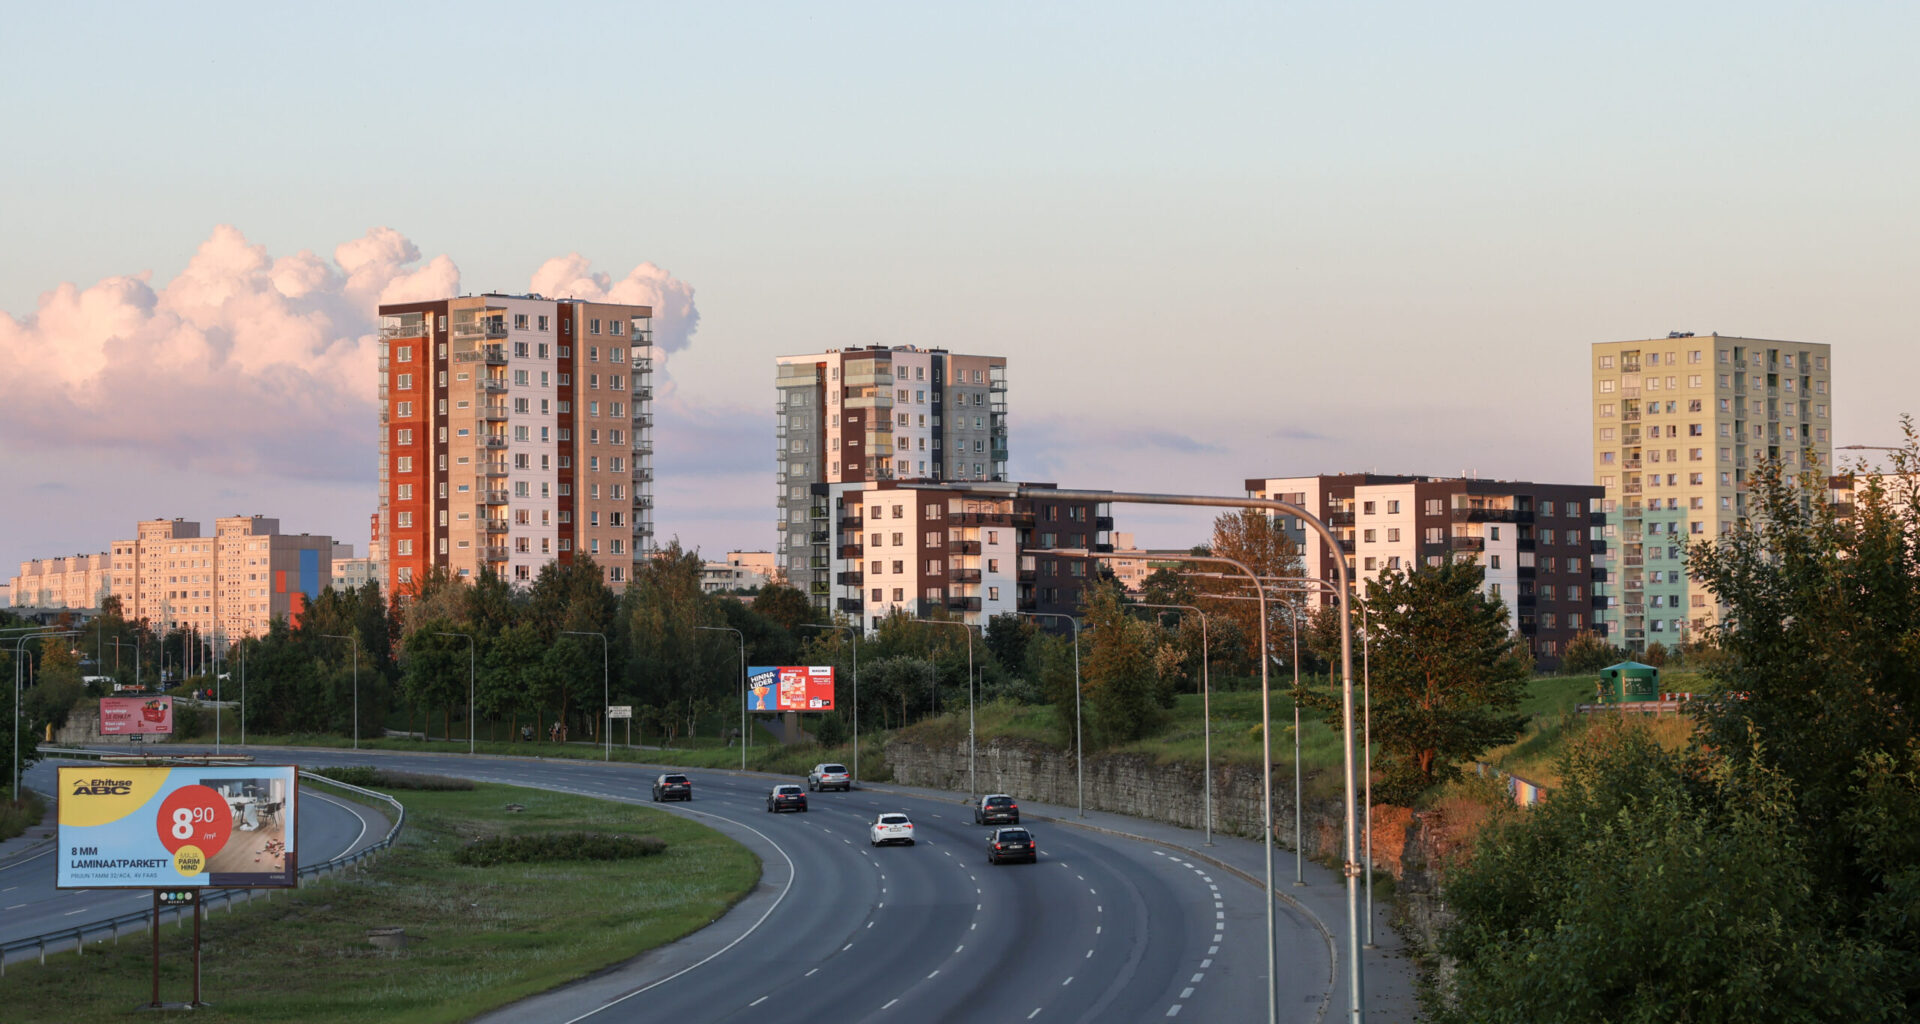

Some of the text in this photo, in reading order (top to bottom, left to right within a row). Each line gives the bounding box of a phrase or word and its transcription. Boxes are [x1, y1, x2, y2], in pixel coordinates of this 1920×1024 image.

[91, 778, 133, 786] Ehituse
[72, 786, 131, 795] ABC
[71, 846, 98, 856] 8 MM
[71, 859, 168, 868] LAMINAATPARKETT
